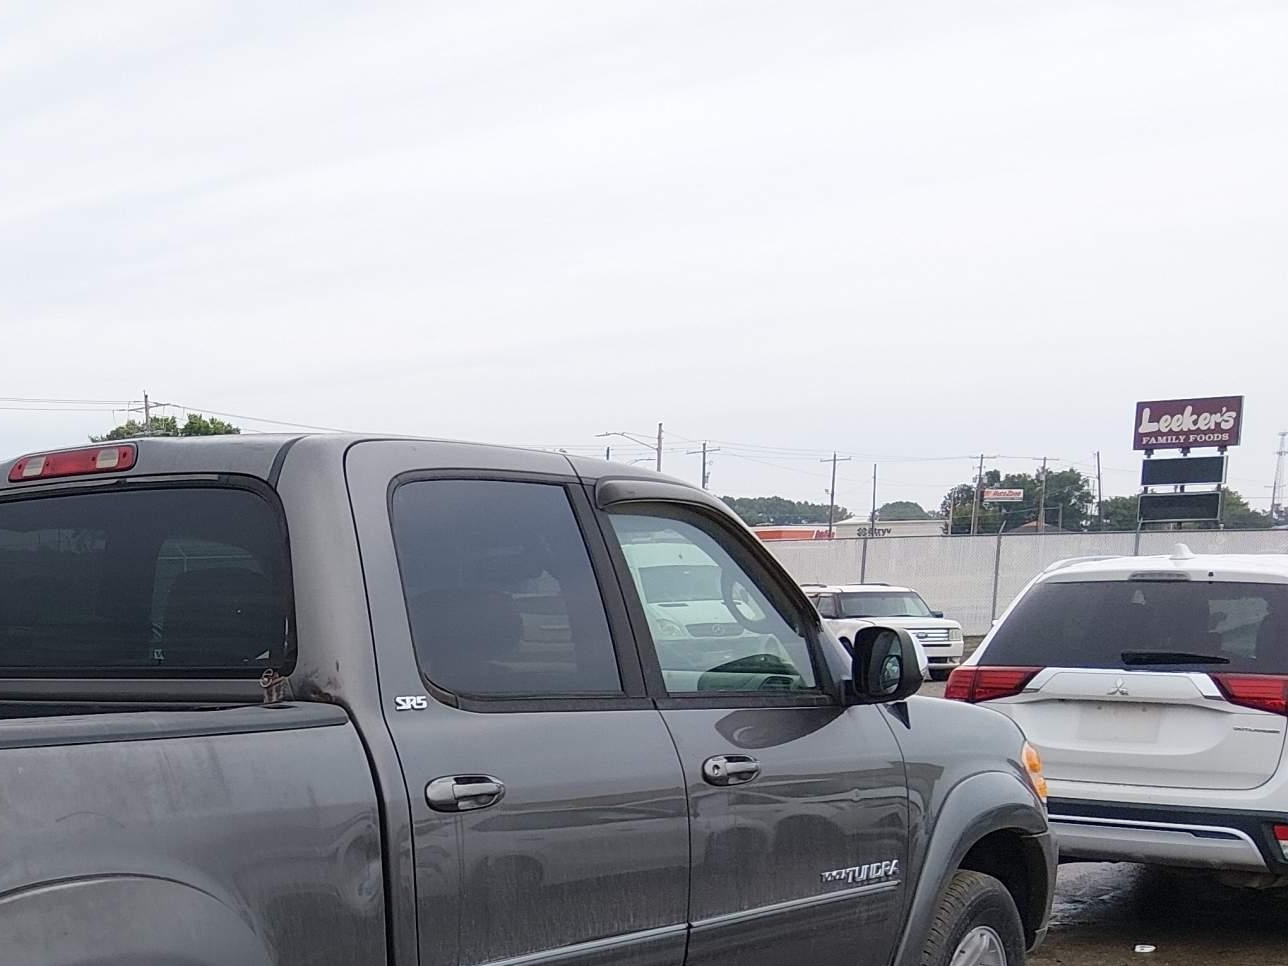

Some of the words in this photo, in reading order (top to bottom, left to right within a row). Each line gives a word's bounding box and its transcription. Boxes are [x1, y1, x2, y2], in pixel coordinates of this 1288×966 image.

[1138, 405, 1237, 433] Leeker's
[1142, 434, 1187, 445] FAMILY
[1188, 433, 1230, 443] FOODS
[395, 695, 428, 710] SR5
